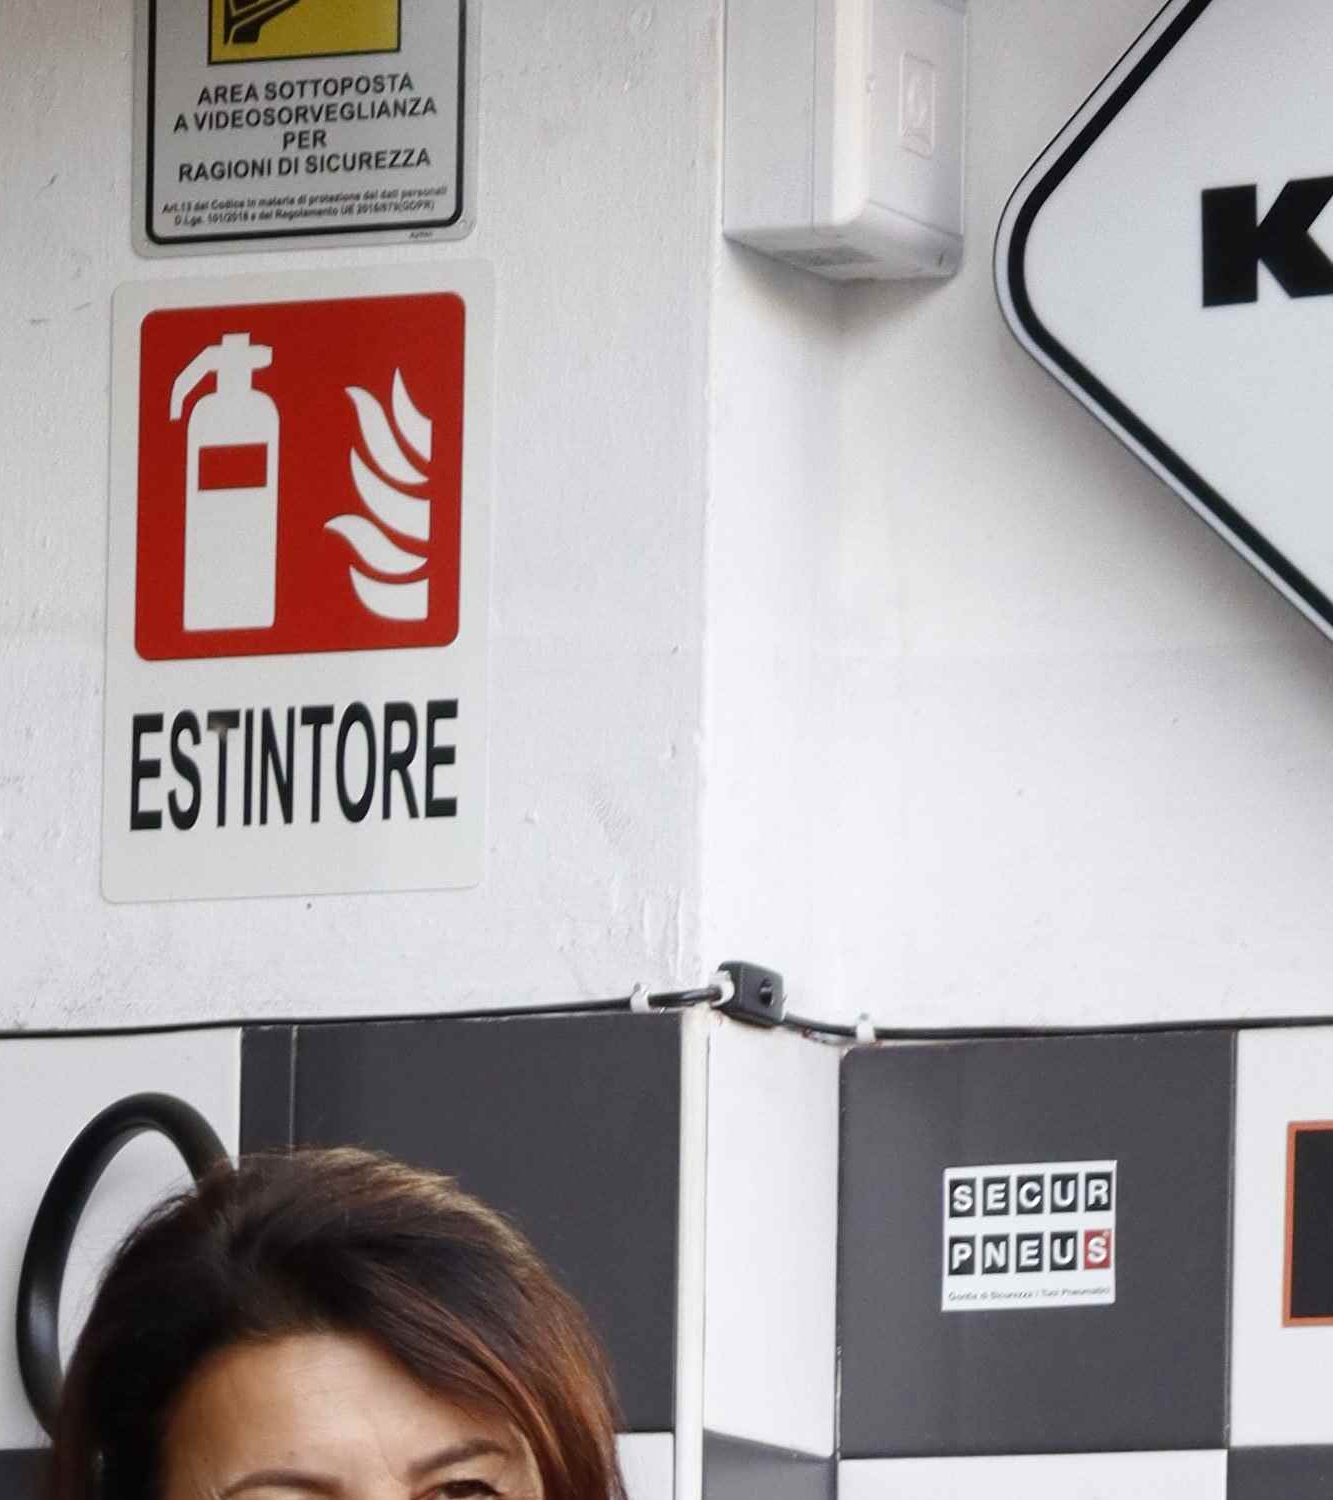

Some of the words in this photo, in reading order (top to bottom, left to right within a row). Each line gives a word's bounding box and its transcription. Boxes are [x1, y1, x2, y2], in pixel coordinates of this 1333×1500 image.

[197, 83, 259, 106] AREA
[264, 72, 414, 101] SOTTOPOSTA
[173, 114, 189, 133] A
[193, 97, 438, 131] VIDEOSORVEGLIANZA
[282, 129, 327, 151] PER
[178, 158, 272, 182] RAGIONI
[277, 156, 300, 175] DI
[304, 148, 432, 174] SICUREZZA
[1201, 175, 1333, 308] K
[130, 698, 459, 832] ESTINTORE
[950, 1178, 1111, 1213] SECUR
[950, 1233, 1110, 1272] PNEUS
